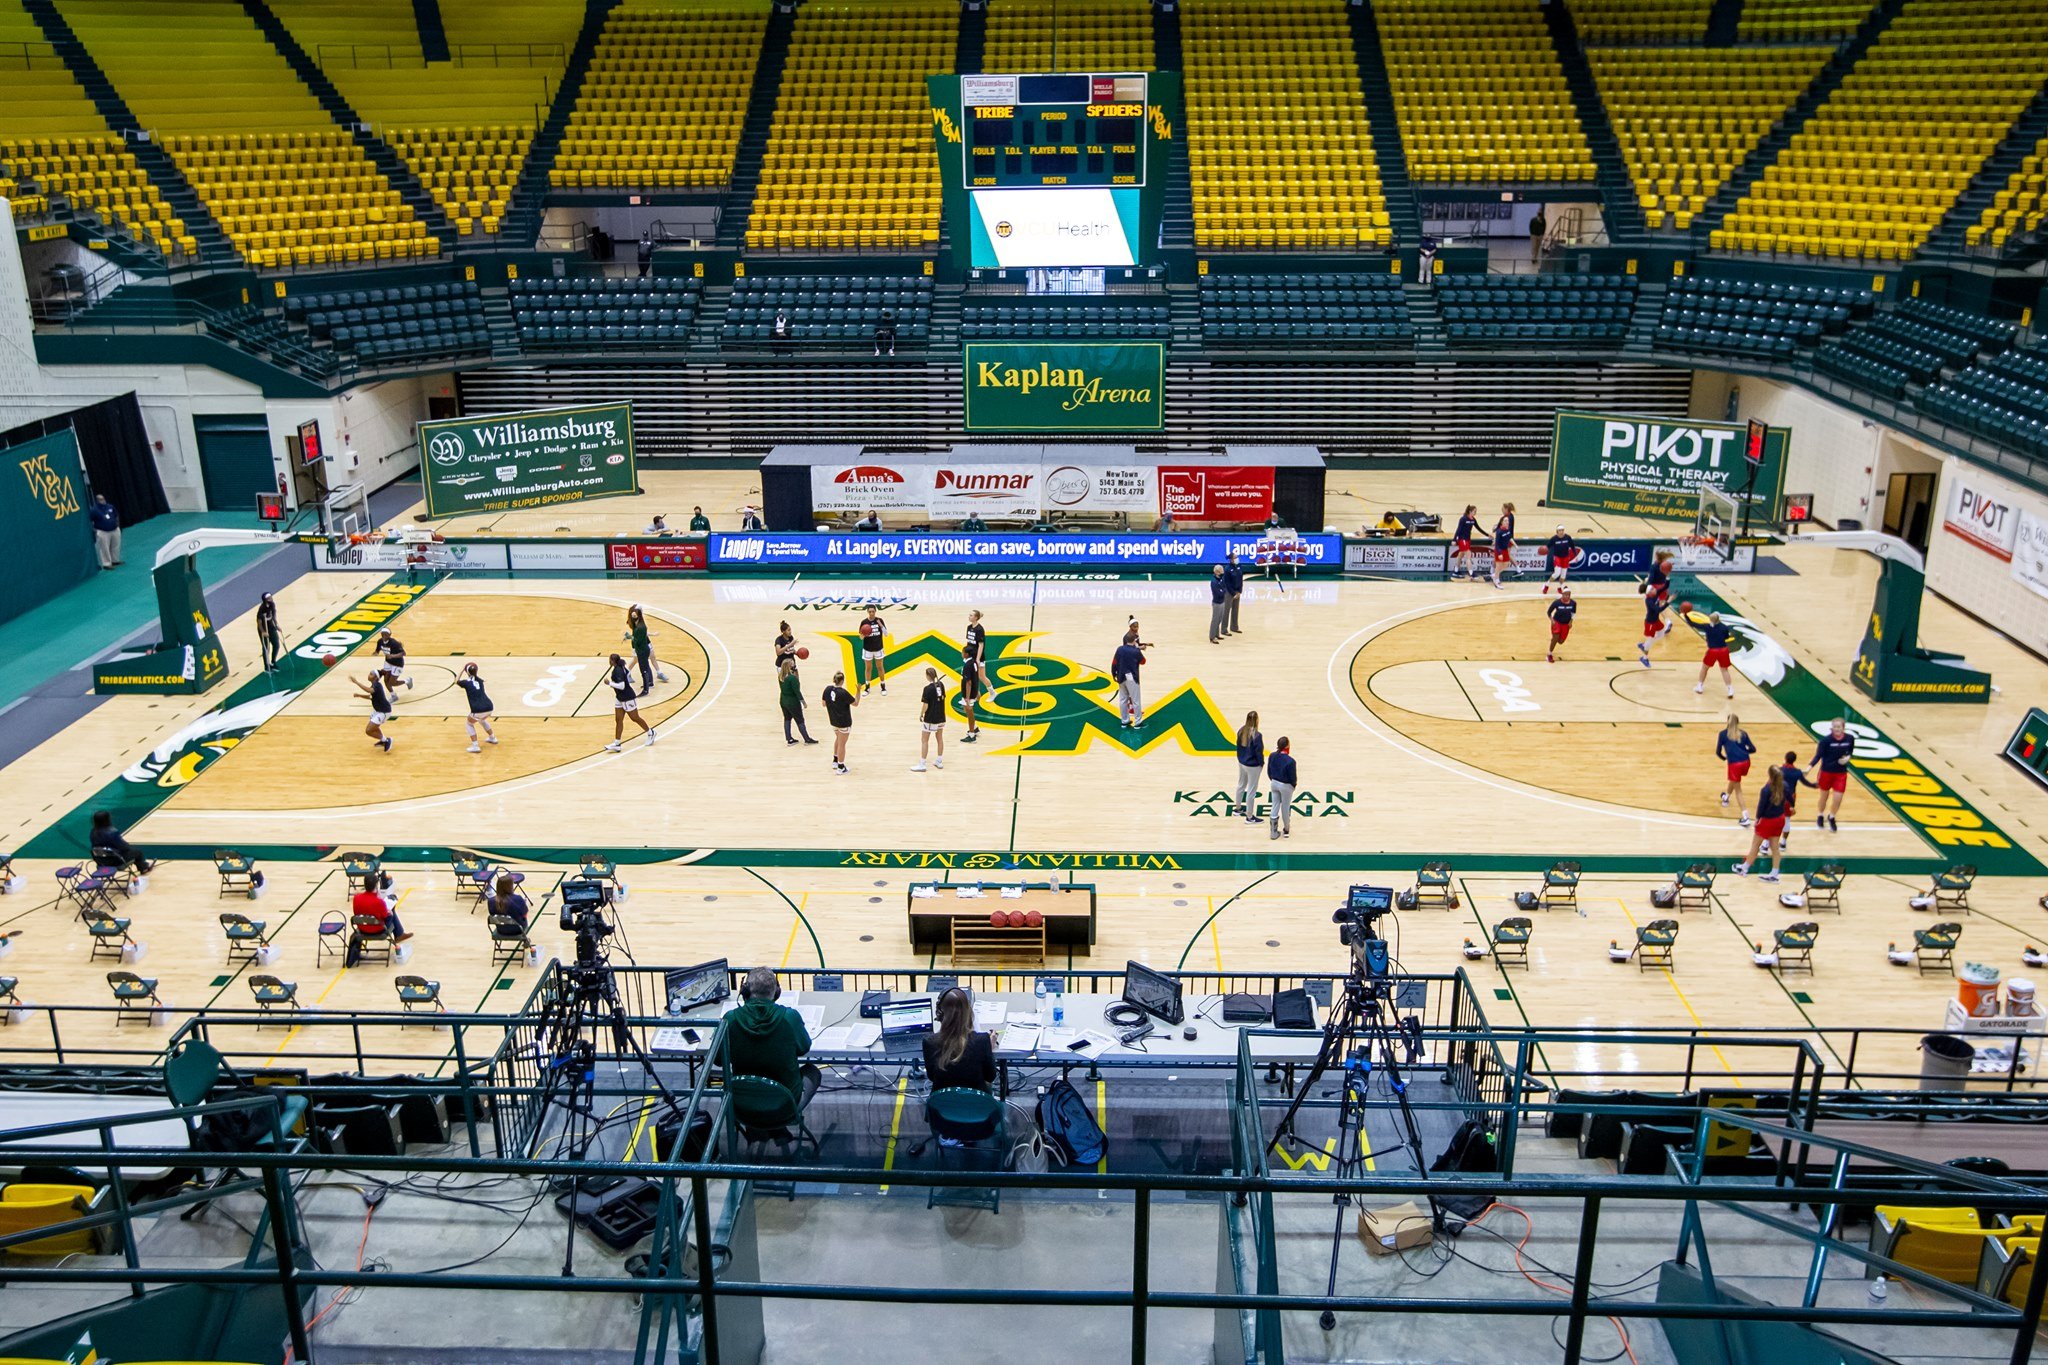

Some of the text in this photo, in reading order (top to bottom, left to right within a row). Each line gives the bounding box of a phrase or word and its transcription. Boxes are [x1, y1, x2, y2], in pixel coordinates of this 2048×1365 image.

[973, 106, 1014, 119] TRIBE
[1041, 112, 1067, 121] PERIOD
[1086, 104, 1143, 117] SPIDERS
[973, 147, 996, 155] FOULS
[1030, 146, 1079, 154] PLAYER FOUL
[1112, 145, 1136, 153] FOULS
[973, 177, 997, 185] SCORE
[1042, 176, 1067, 184] MATCH
[1112, 176, 1136, 184] SCORE
[1058, 221, 1110, 236] Health
[977, 362, 1085, 394] Kaplan
[1062, 377, 1151, 411] Arena
[472, 417, 616, 448] Williamsburg
[468, 437, 624, 463] Chrysler Jeep Dodge Ram Kia
[1601, 420, 1735, 467] PIVOT
[441, 471, 480, 480] CHRYSLER
[844, 468, 894, 483] Anna's
[1600, 461, 1730, 483] PHYSICAL THERAPY
[1603, 472, 1624, 481] John
[1627, 474, 1662, 485] Mitrovic
[935, 470, 1034, 489] Dunmar
[1099, 479, 1115, 487] 5143
[1137, 479, 1145, 487] St
[1563, 476, 1695, 494] Exclusive Physical Therapy Providers
[19, 453, 80, 520] W&M
[464, 476, 604, 501] www.WilliamsburgAuto.com
[1165, 484, 1185, 493] The
[483, 491, 583, 511] TRIBE SUPER SPONSOR
[1165, 493, 1200, 503] Supply
[1165, 501, 1195, 510] Room
[1603, 501, 1666, 515] TRIBE SUPER
[1959, 487, 2009, 533] PIVOT
[719, 537, 765, 560] Langley
[790, 549, 809, 557] Wisely
[827, 539, 1205, 559] At Langley, EVERYONE can save, borrow and spend wisely
[1588, 549, 1636, 566] pepsi
[799, 596, 909, 604] ARENA
[99, 675, 185, 685] TRIBEATHLETICS.COM
[1891, 682, 1986, 693] TRIBEATHLETICS.COM
[840, 852, 958, 867] MARY
[1010, 853, 1183, 870] WILLIAM
[1978, 1020, 2028, 1028] GATORADE
